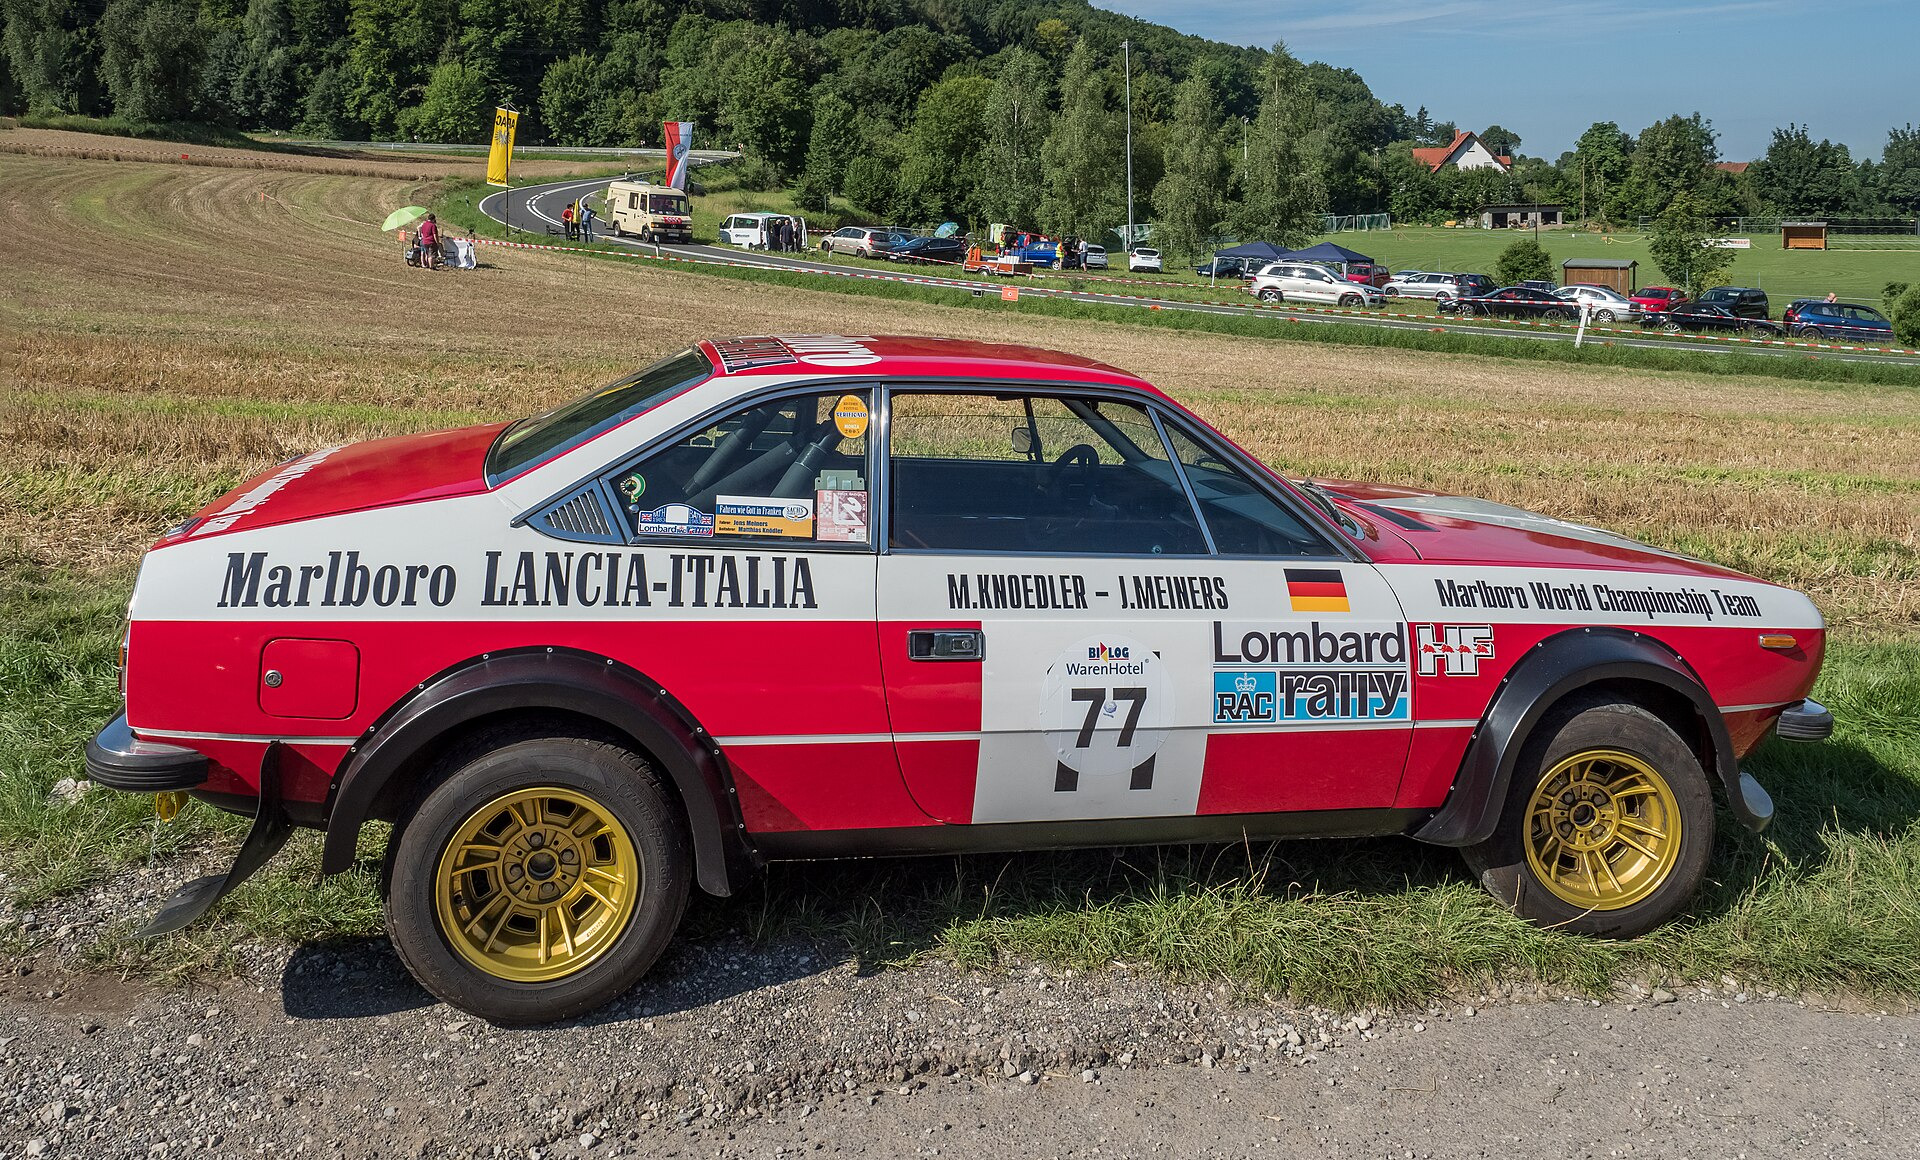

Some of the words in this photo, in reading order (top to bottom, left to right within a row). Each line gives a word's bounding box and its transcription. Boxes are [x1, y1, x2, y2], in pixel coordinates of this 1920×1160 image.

[640, 525, 677, 533] Lombard
[720, 504, 737, 514] Fahren
[738, 506, 746, 514] wie
[757, 507, 762, 515] in
[762, 507, 782, 516] Franken
[217, 551, 457, 607] Marlboro
[481, 551, 818, 608] LANCIA-ITALIA
[947, 574, 1088, 609] M.KNOEDLER
[1118, 575, 1229, 609] J.MEINERS
[1434, 579, 1528, 609] Marlboro
[1528, 581, 1591, 612] World
[1592, 584, 1714, 621] Championship
[1710, 589, 1762, 617] Team
[1213, 621, 1406, 663] Lombard
[1416, 623, 1494, 676] HF
[1217, 692, 1273, 720] RAC
[1282, 672, 1407, 719] rally
[1071, 687, 1148, 748] 77
